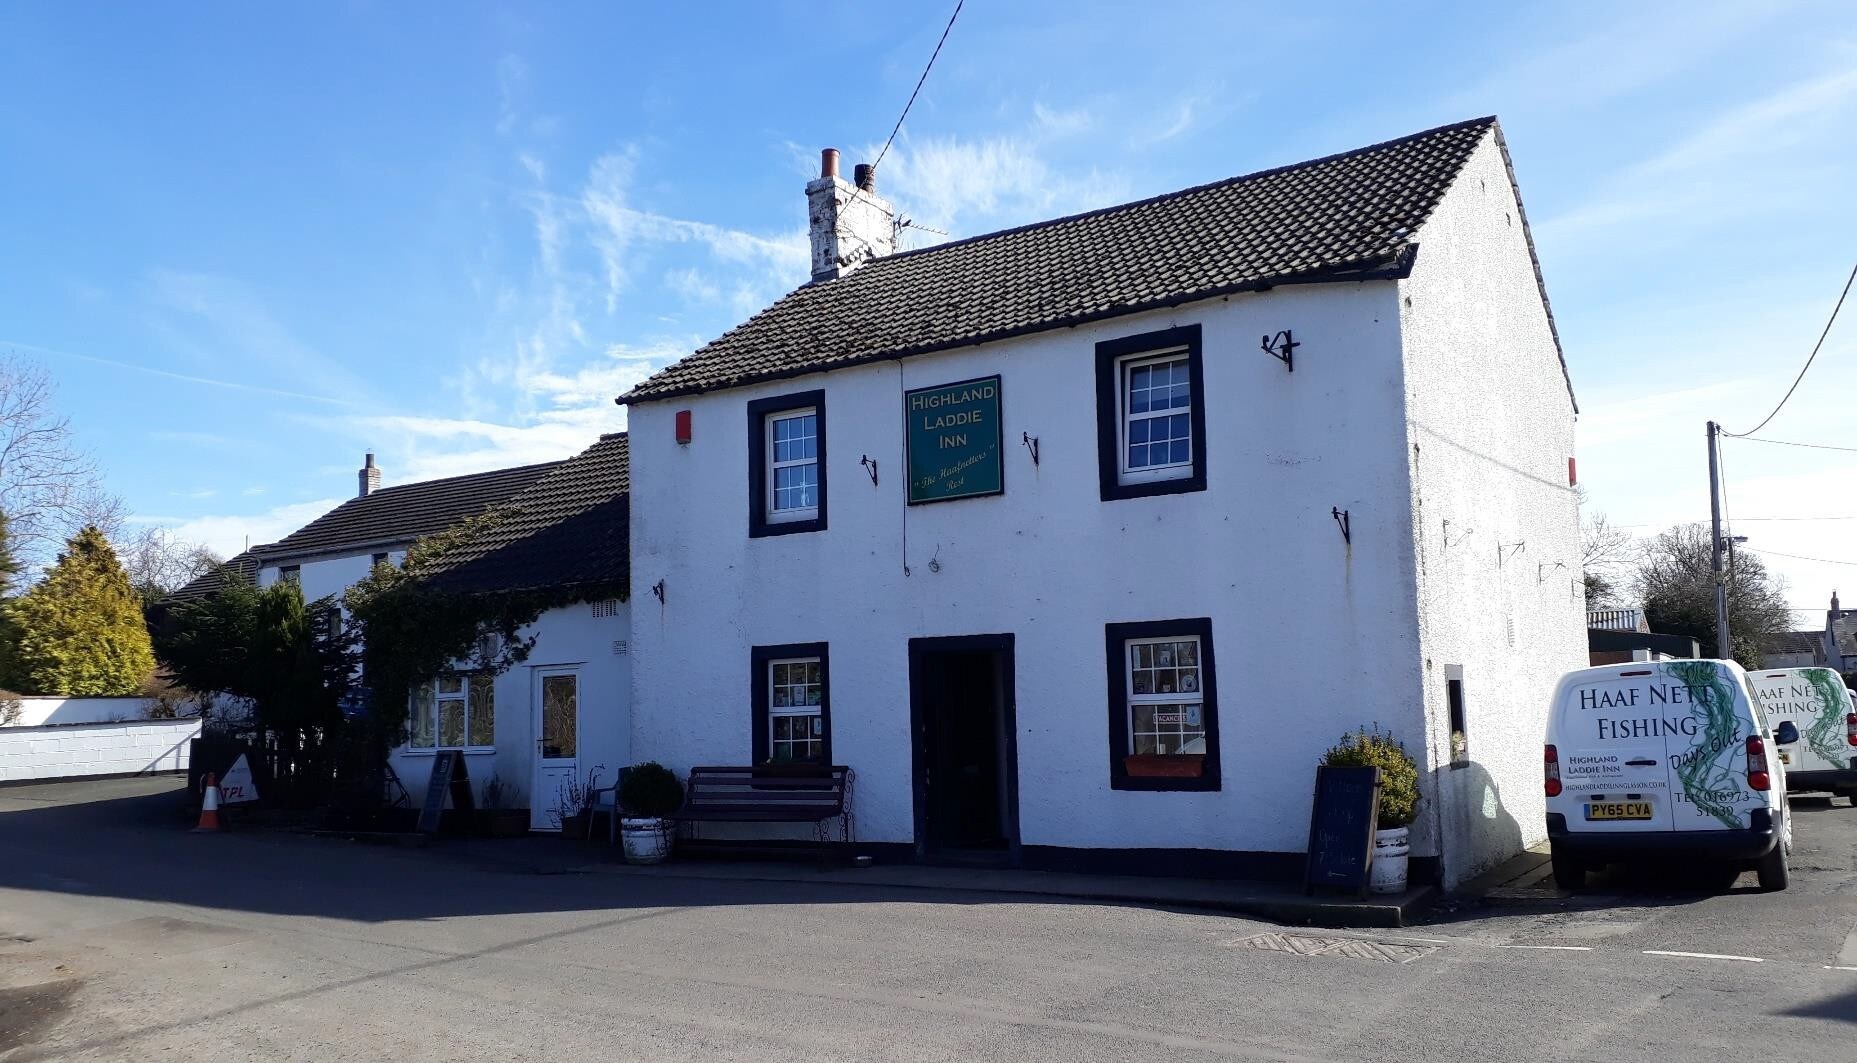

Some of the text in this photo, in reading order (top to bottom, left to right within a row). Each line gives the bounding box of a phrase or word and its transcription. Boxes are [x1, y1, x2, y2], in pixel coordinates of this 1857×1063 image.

[912, 386, 994, 411] HIGHLAND
[924, 410, 983, 431] LADDIE
[939, 434, 967, 449] INN
[944, 476, 964, 491] Rest
[1579, 688, 1640, 710] HAAF
[1759, 687, 1785, 700] AAF
[1597, 717, 1697, 740] FISHING
[1669, 727, 1741, 771] Days Out
[1569, 755, 1618, 765] HIGHLAND
[1568, 765, 1621, 775] LADDIE INN
[1704, 790, 1750, 803] 016973
[1592, 803, 1650, 816] PY65 CVA
